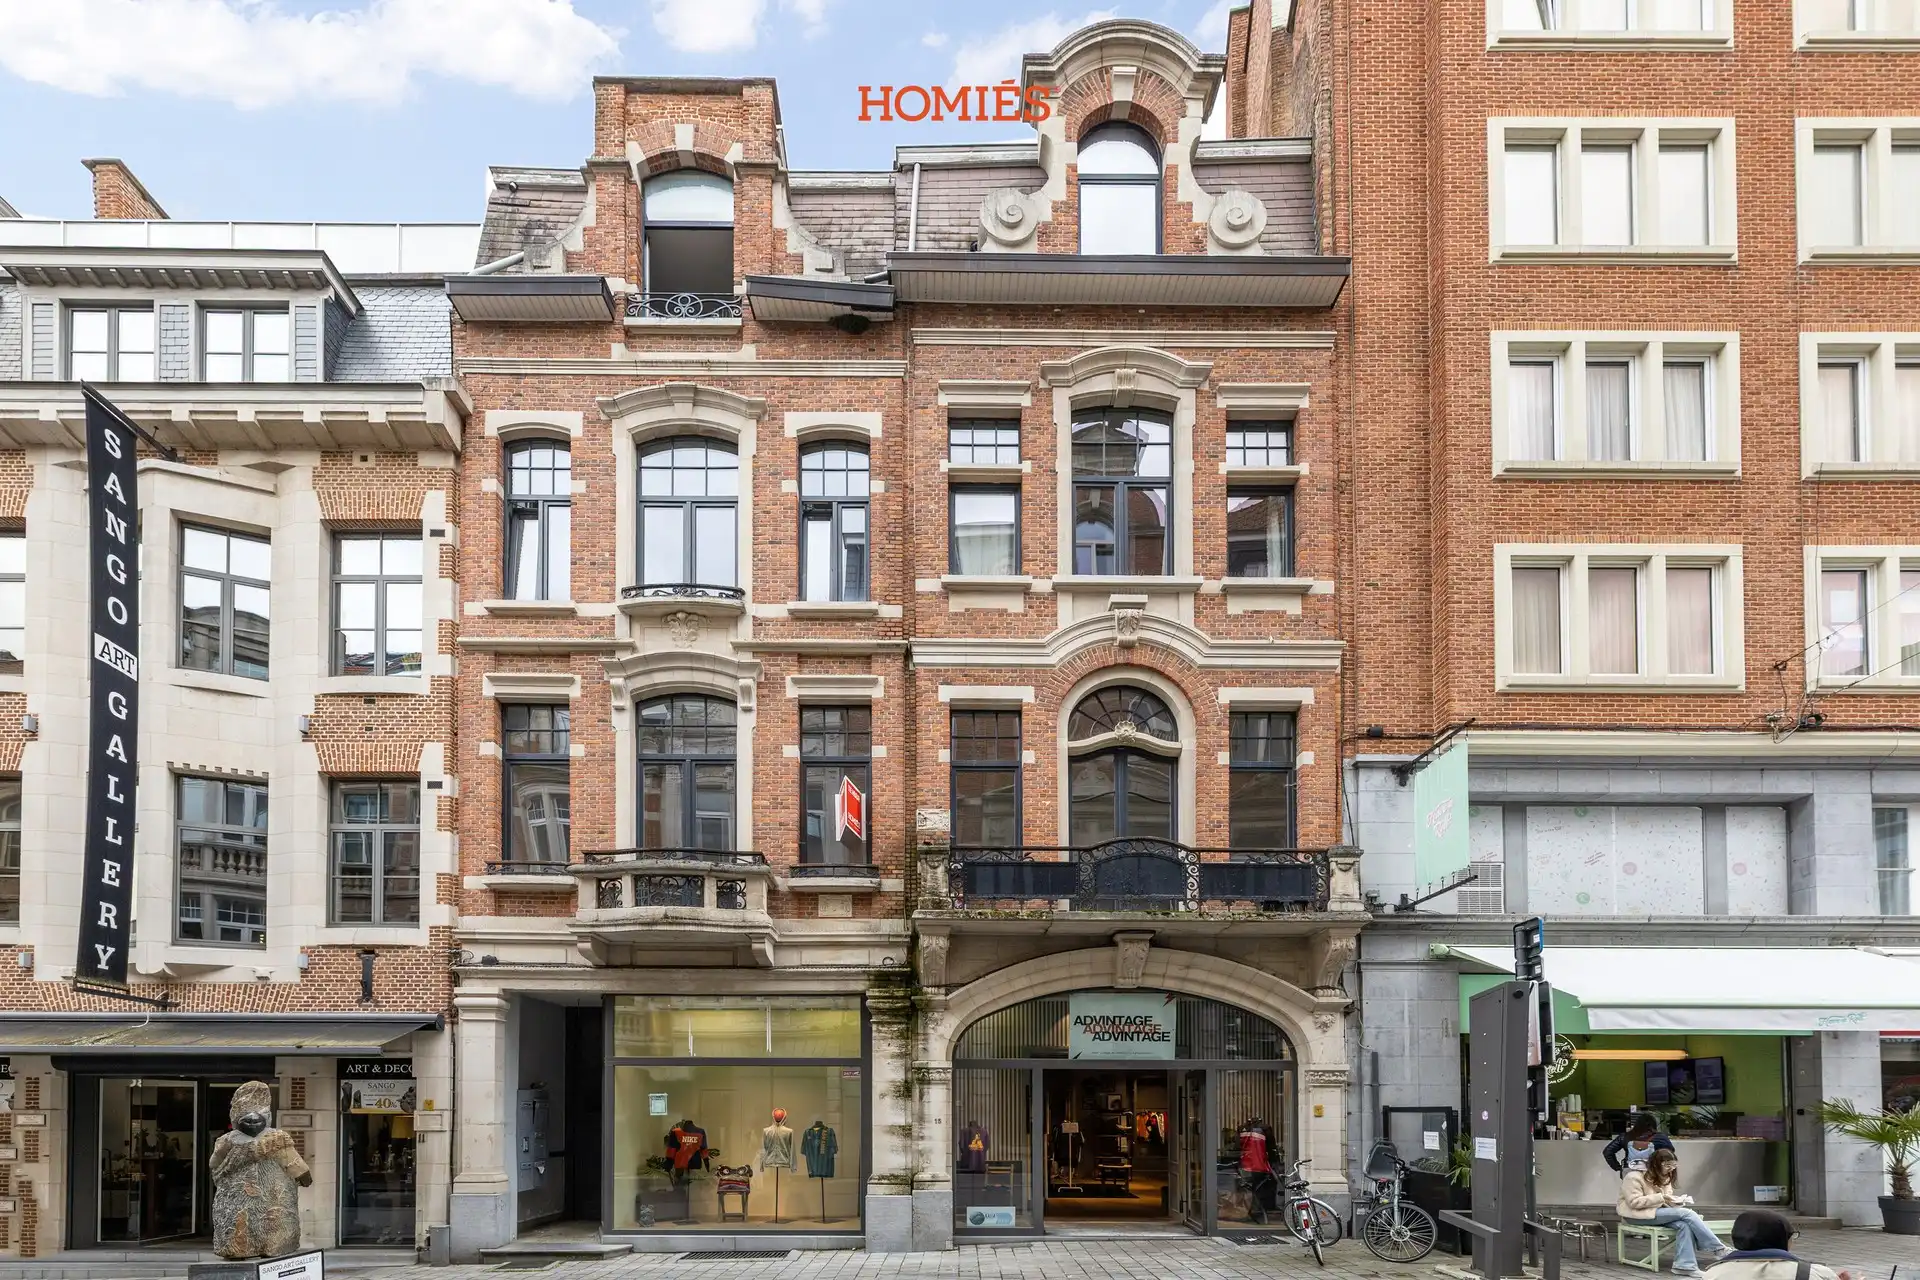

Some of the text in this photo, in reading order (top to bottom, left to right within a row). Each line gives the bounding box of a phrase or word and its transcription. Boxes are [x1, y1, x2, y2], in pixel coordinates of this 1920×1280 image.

[94, 428, 136, 970] SANGO ART GALLERY
[1074, 1015, 1153, 1026] ADVINTAGE
[1083, 1024, 1162, 1034] ADVINTAGE
[1092, 1031, 1171, 1042] ADVINTAGE
[346, 1064, 370, 1073] ART
[372, 1064, 381, 1073] &
[368, 1082, 396, 1090] SANGO
[681, 1135, 699, 1144] NIKE
